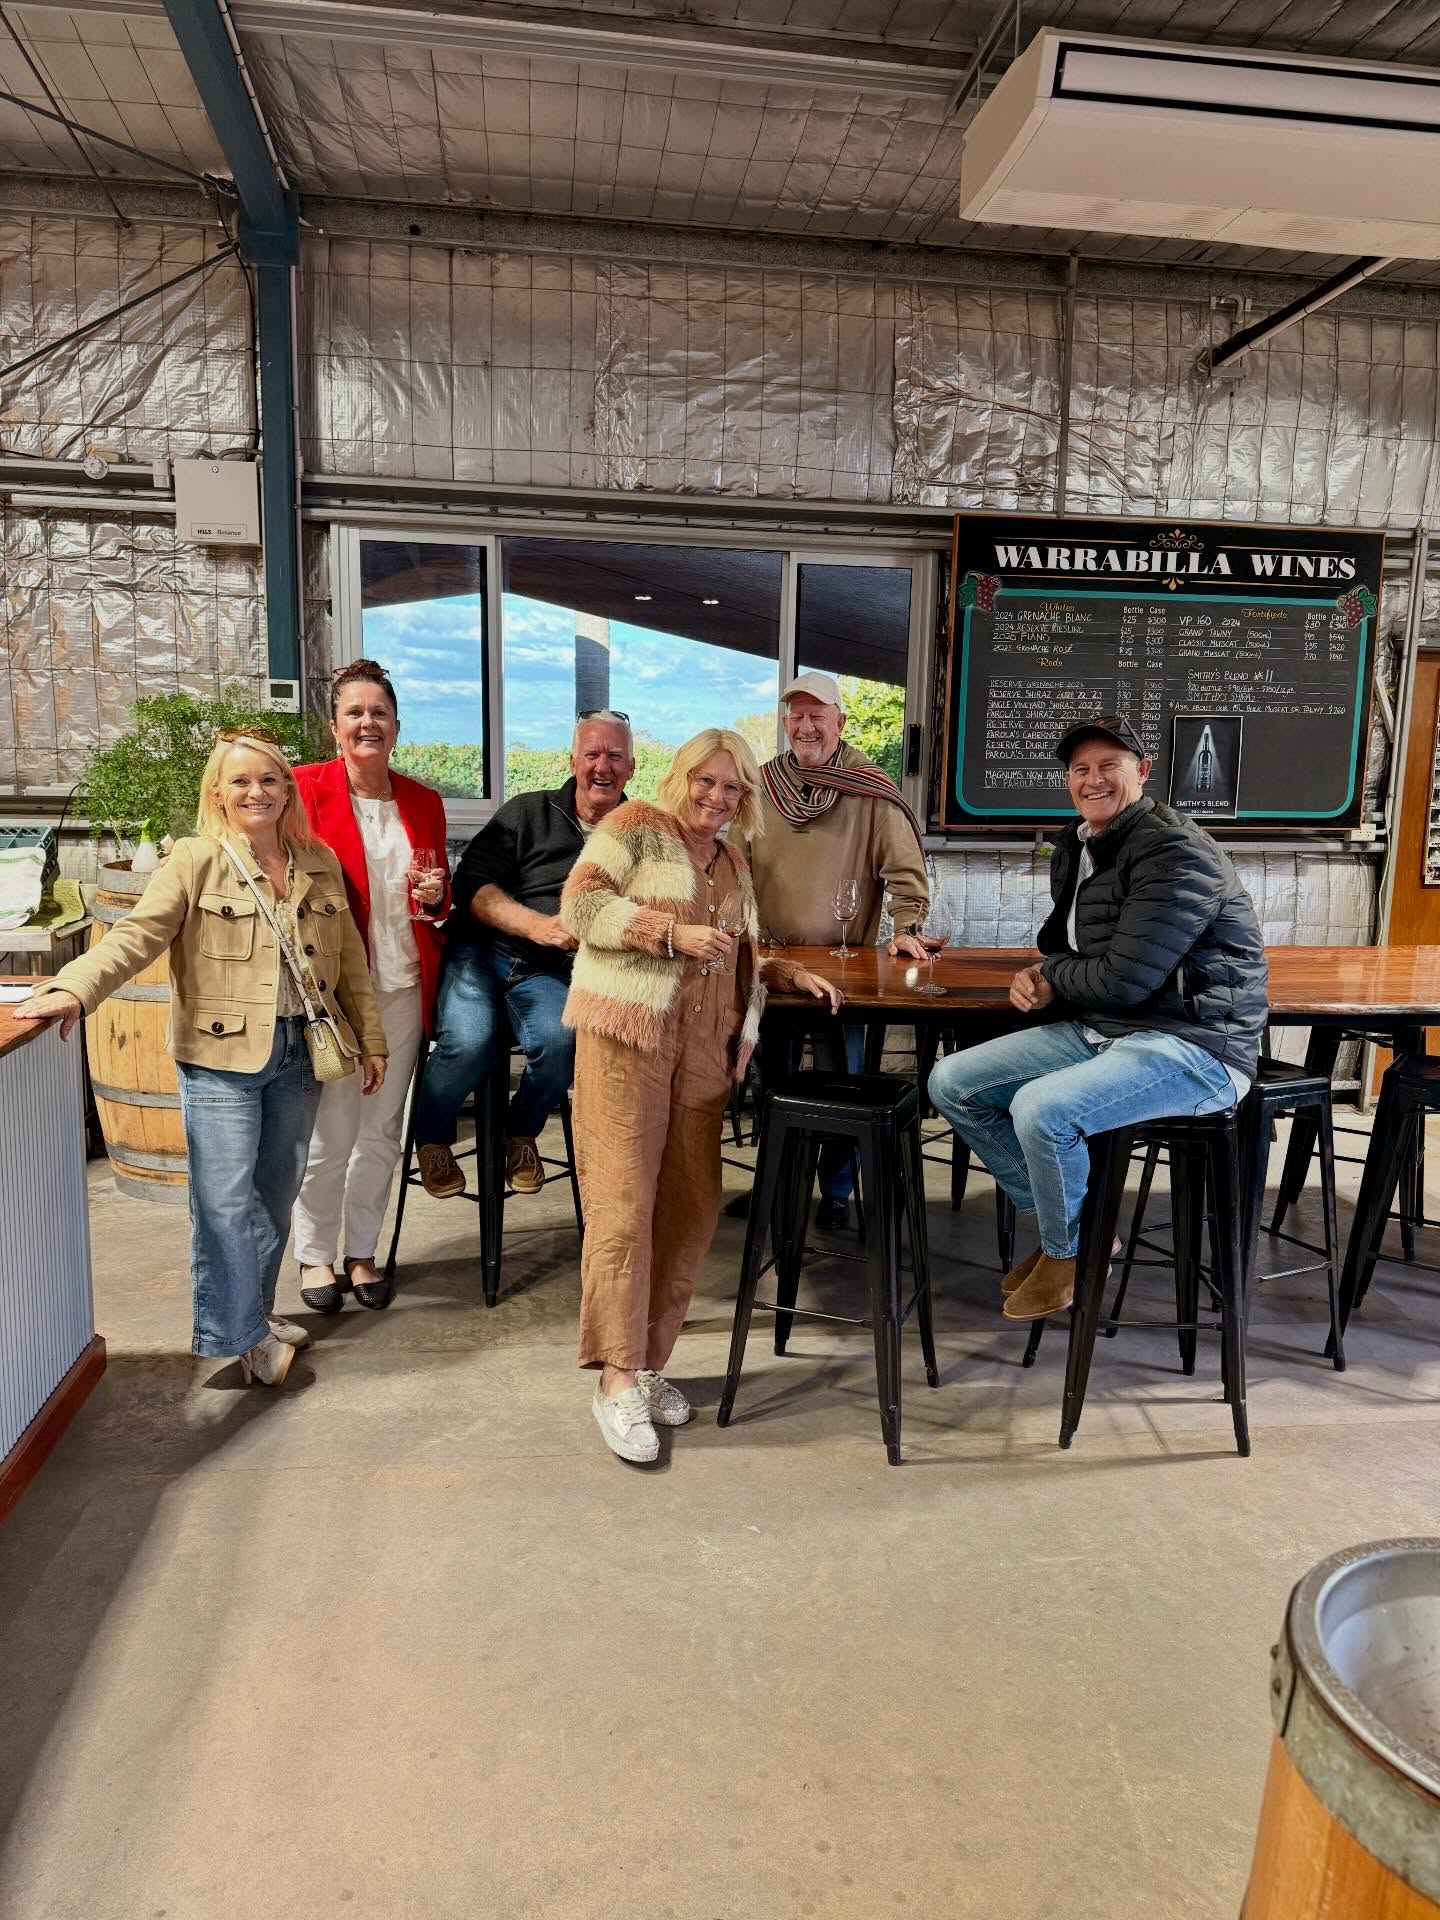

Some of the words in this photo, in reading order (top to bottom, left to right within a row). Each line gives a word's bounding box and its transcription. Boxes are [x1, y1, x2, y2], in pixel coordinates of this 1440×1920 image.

[994, 545, 1233, 575] WARRABILLA
[1250, 554, 1356, 579] WINES
[1040, 602, 1074, 612] Whites
[1124, 606, 1143, 614] Bottle
[995, 611, 1013, 619] 2024
[1018, 611, 1061, 621] GRENACHE
[1066, 613, 1093, 623] BLANC
[1242, 609, 1287, 619] Fortifieds
[1122, 615, 1136, 624] $25
[1180, 616, 1192, 626] VP
[1197, 615, 1211, 625] 160
[1222, 618, 1240, 626] 2024
[1304, 620, 1320, 630] $30
[1020, 632, 1050, 642] FIANO
[1208, 628, 1232, 639] TAWNY
[1036, 658, 1063, 667] Reds
[1188, 668, 1220, 680] SMITHY'S
[1224, 671, 1248, 680] BLEND
[989, 689, 1021, 698] RESERVE
[1026, 690, 1051, 698] SHIRAZ
[1117, 691, 1131, 700] $30
[988, 700, 1011, 708] SINGLE
[1013, 701, 1045, 709] VINEYARD
[1049, 701, 1073, 709] SHIRAZ
[986, 709, 1020, 718] PAROLA'S
[1141, 712, 1160, 720] $540
[986, 720, 1025, 728] RESERVE
[986, 729, 1020, 738] PAROLA'S
[1023, 730, 1062, 739] CABERNET
[1141, 731, 1161, 740] $540
[986, 740, 1020, 749] RESERVE
[1026, 741, 1048, 749] DURIF
[985, 750, 1023, 759] PAROLA'S
[1030, 751, 1053, 759] DURIF
[986, 771, 1024, 779] MAGNUMS
[1047, 771, 1065, 779] AVAIL
